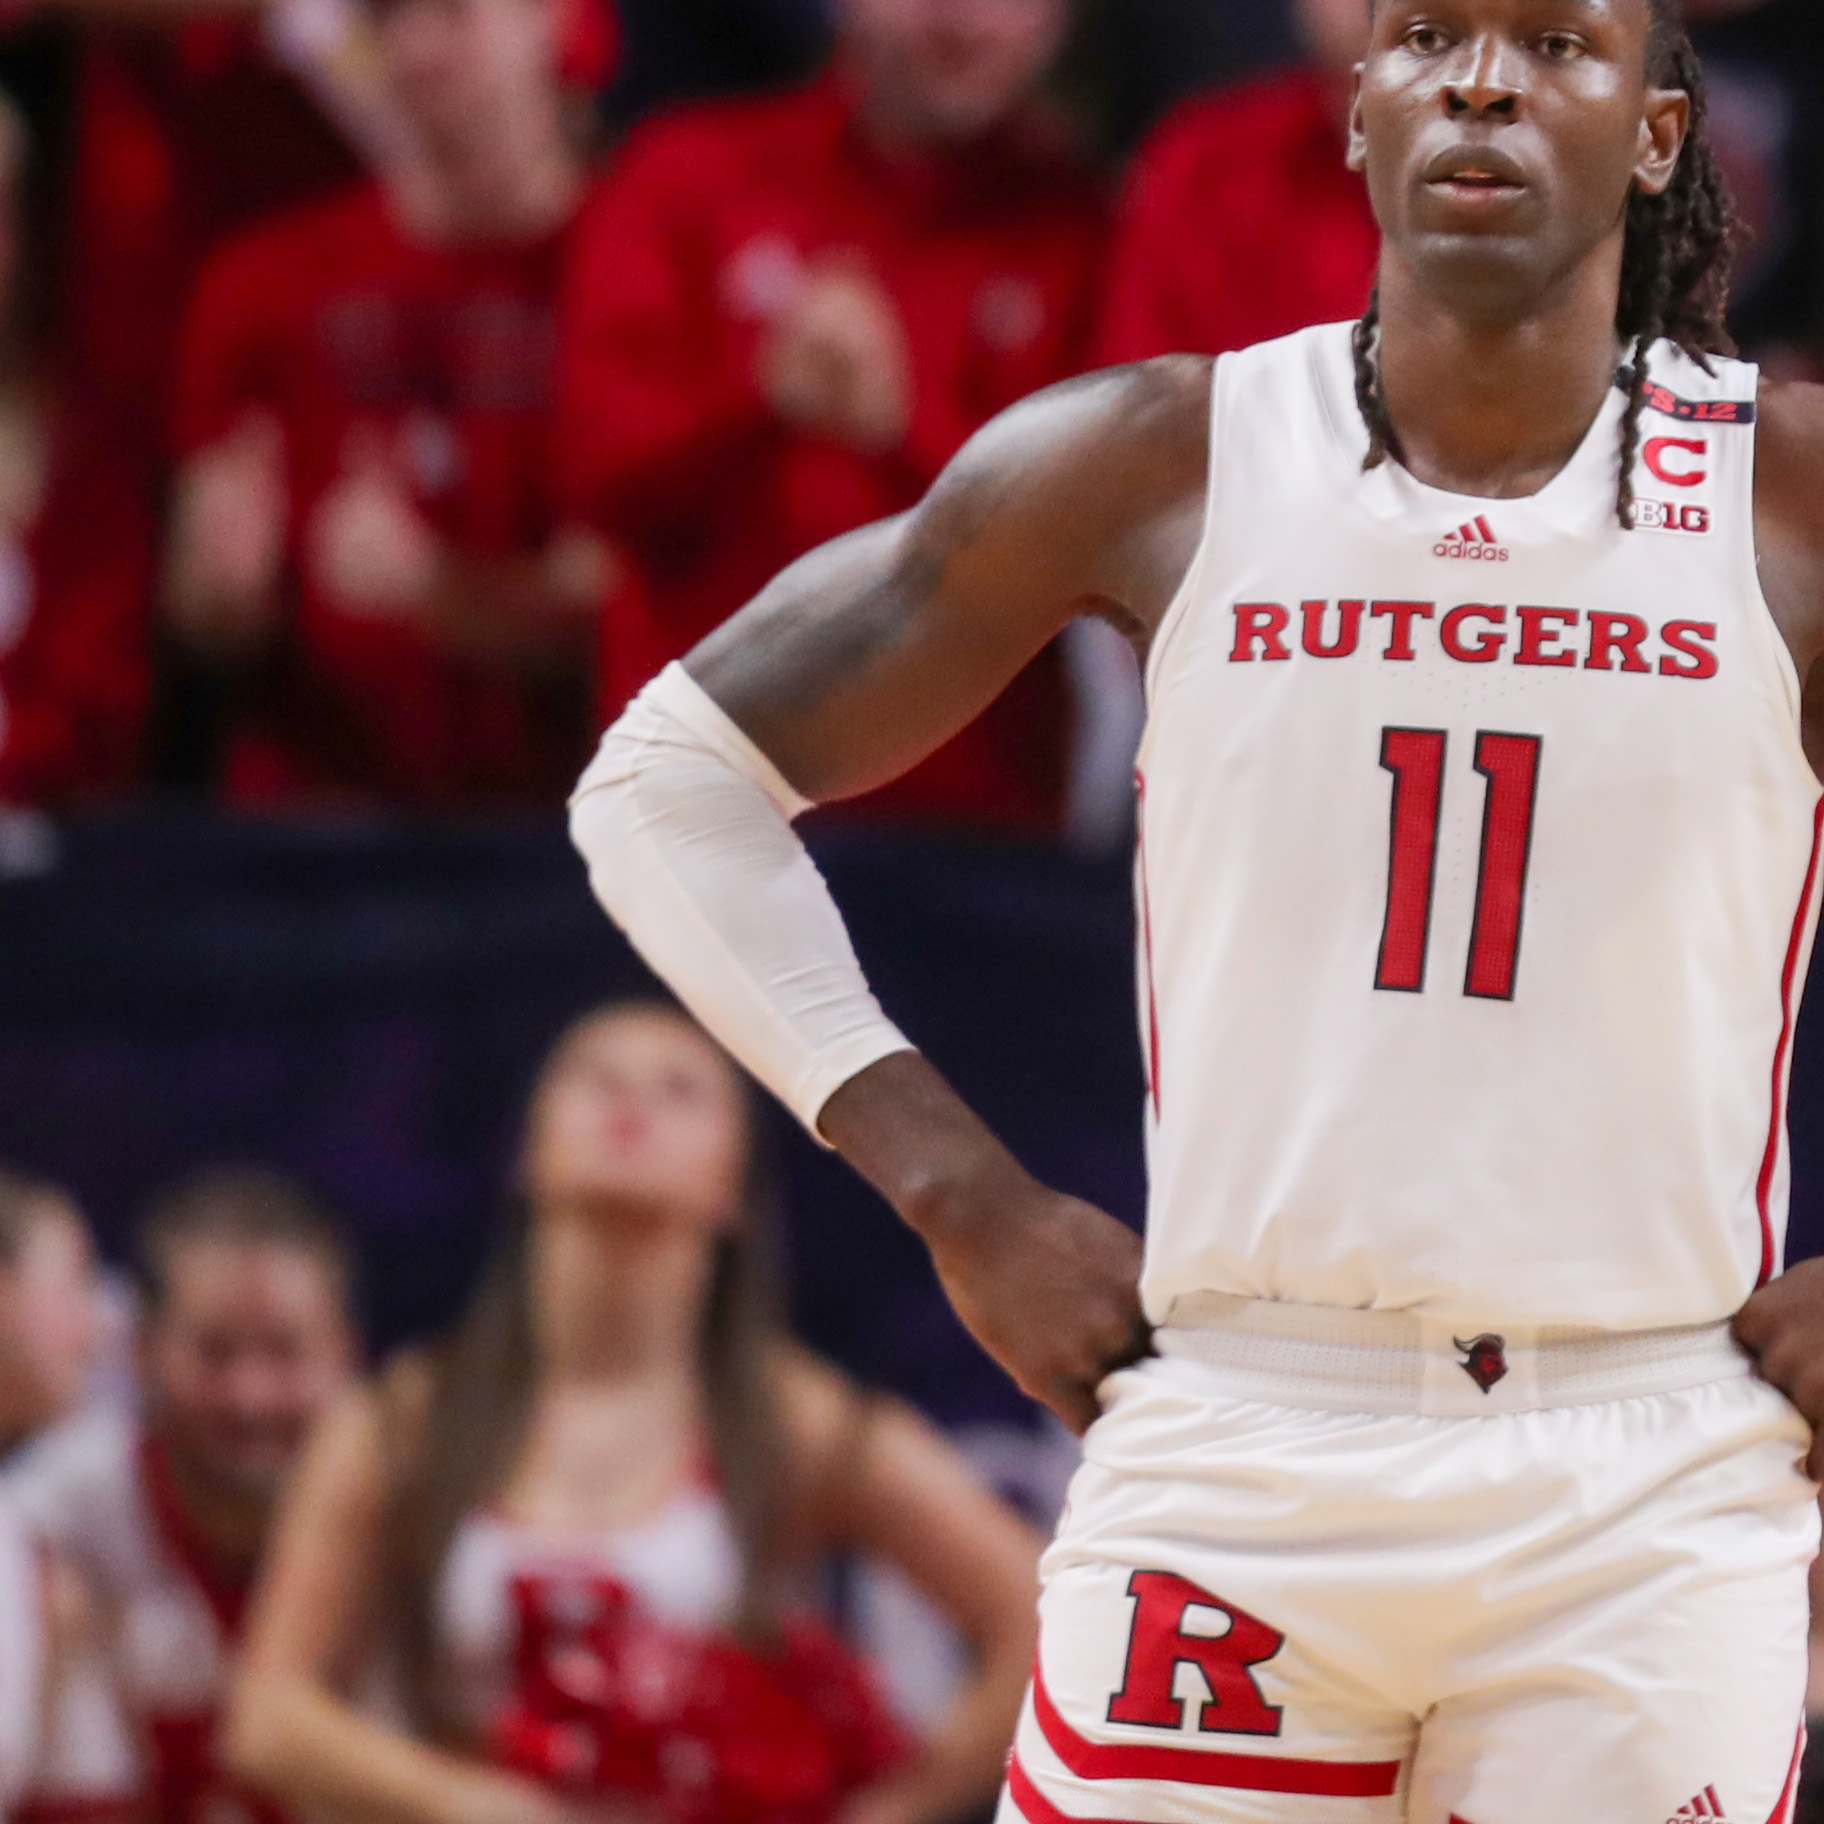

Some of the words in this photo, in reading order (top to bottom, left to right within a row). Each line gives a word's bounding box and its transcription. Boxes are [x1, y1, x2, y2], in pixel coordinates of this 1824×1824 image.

[1643, 436, 1708, 489] C
[1432, 541, 1510, 563] adidas
[1227, 598, 1720, 680] RUTGERS
[1373, 725, 1544, 1002] 11
[1105, 1568, 1286, 1738] R
